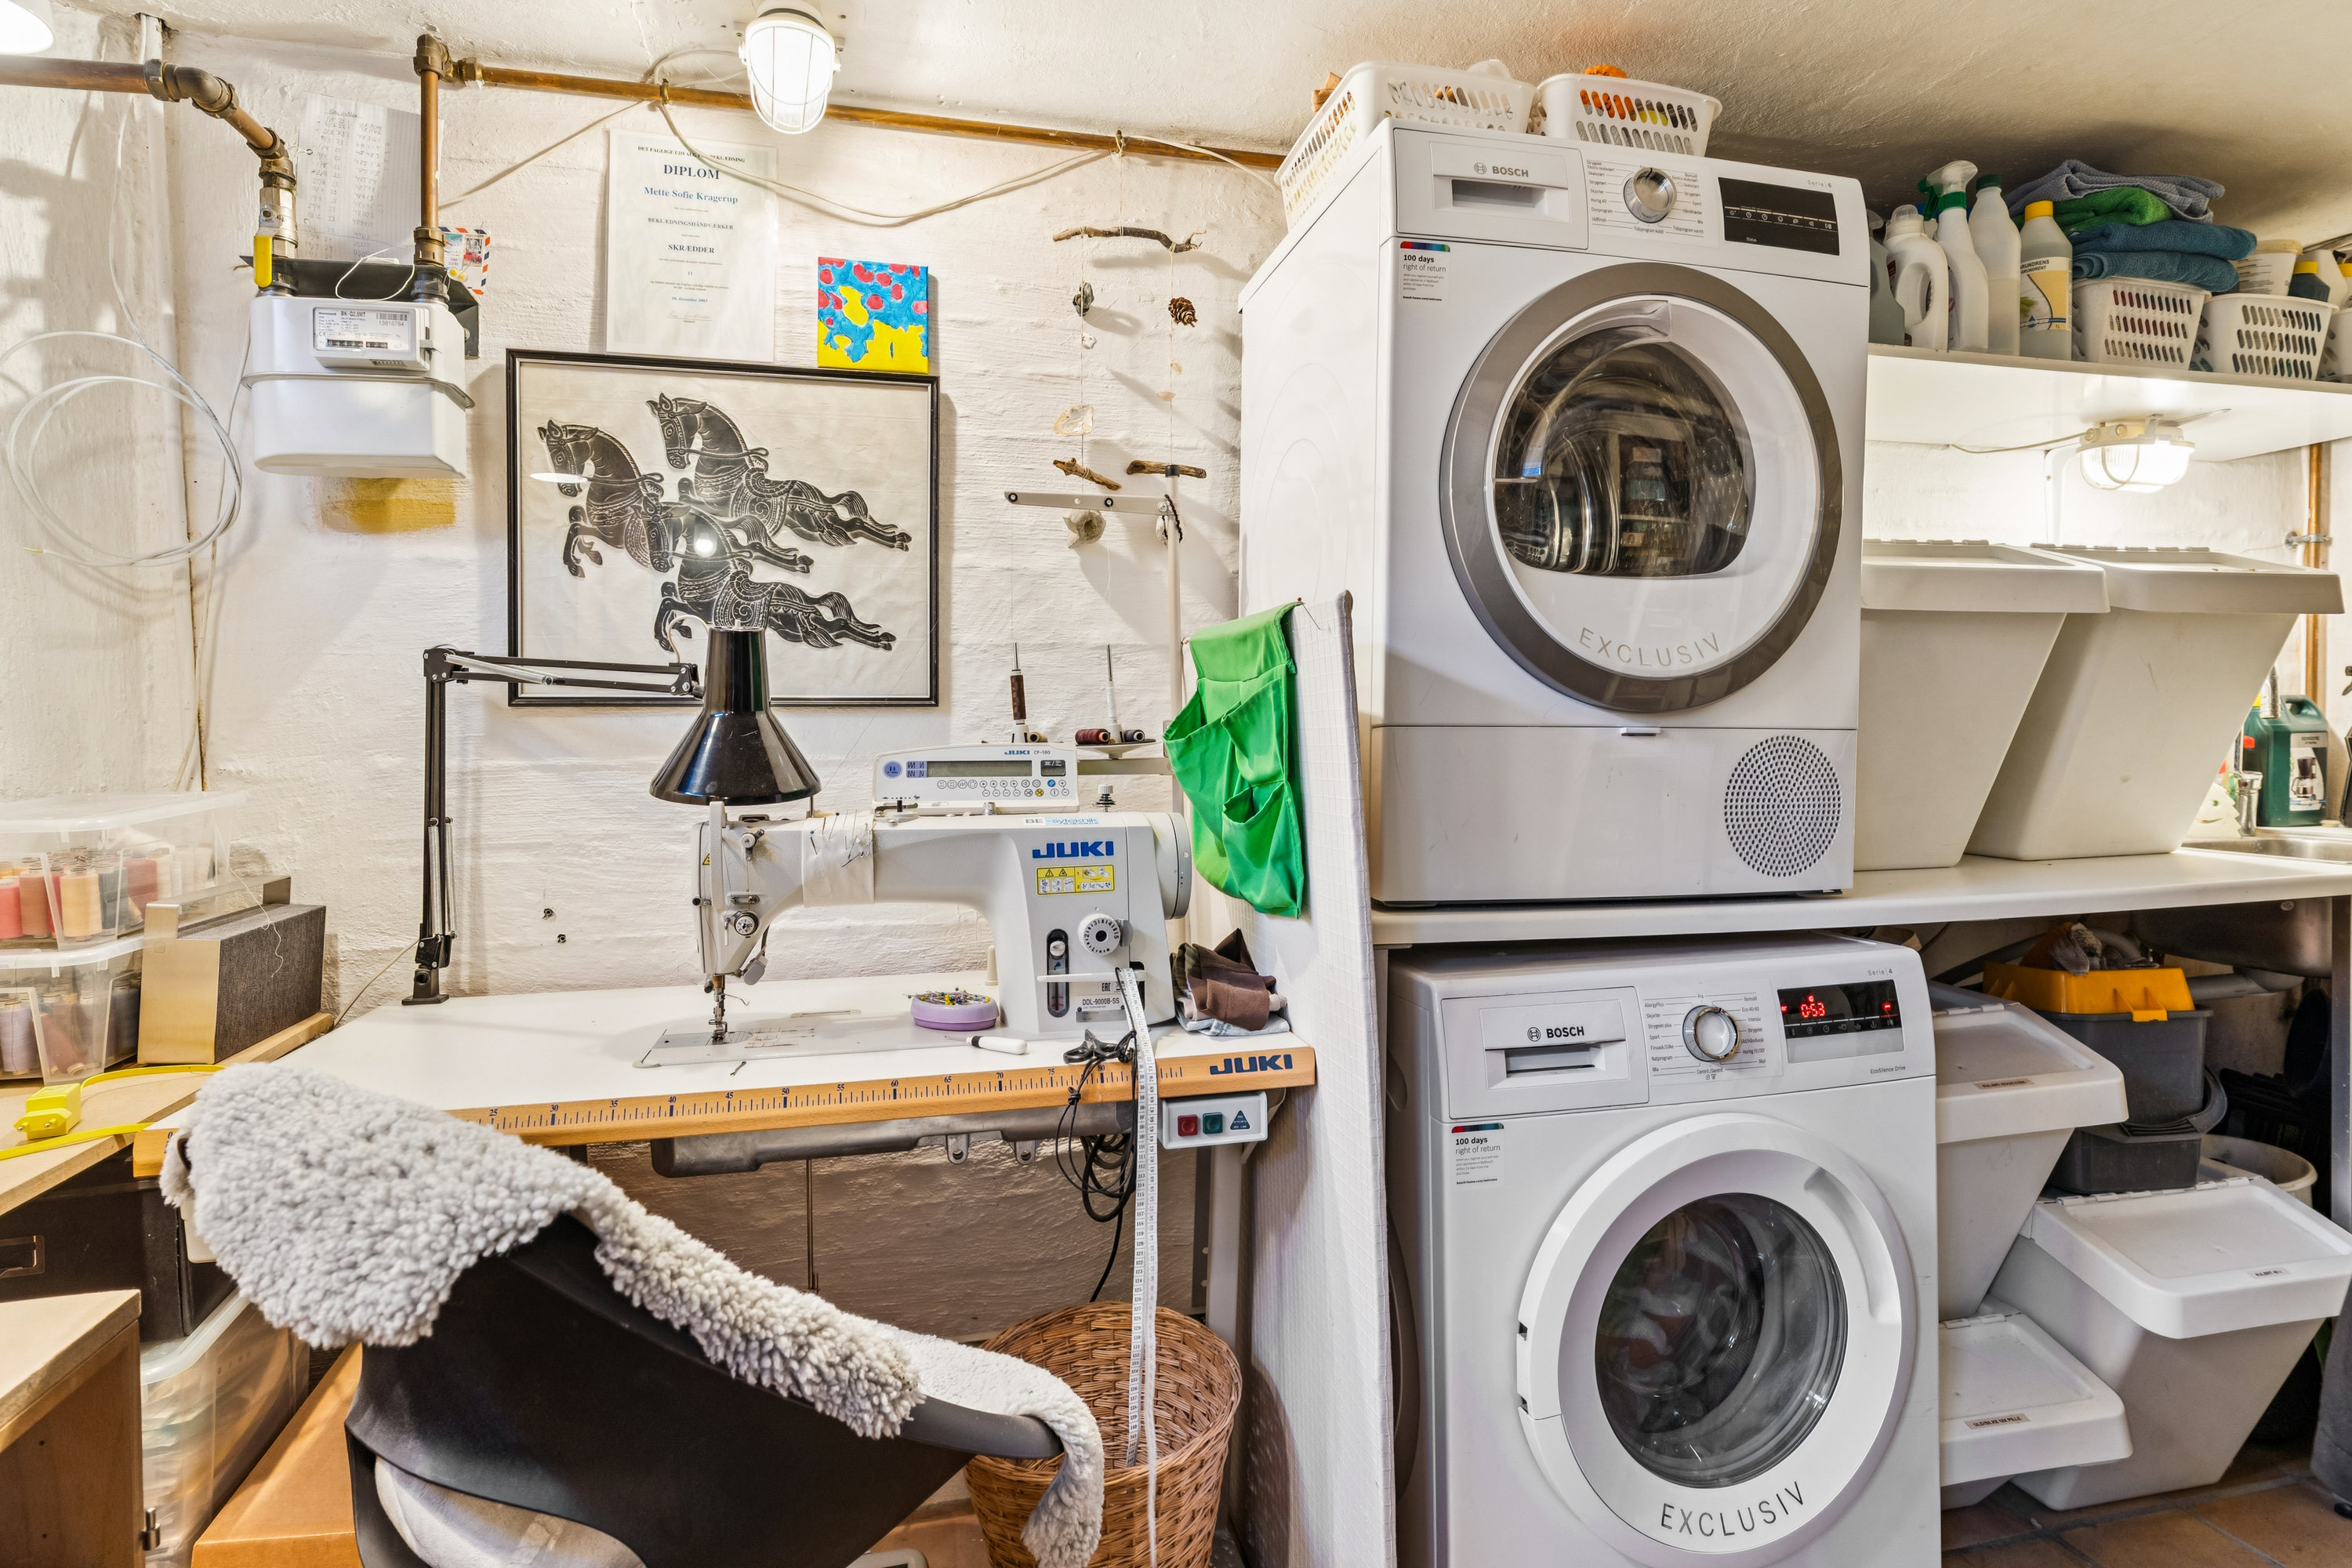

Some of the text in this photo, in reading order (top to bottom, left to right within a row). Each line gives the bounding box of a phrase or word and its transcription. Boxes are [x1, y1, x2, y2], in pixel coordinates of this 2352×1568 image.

[663, 164, 720, 179] DIPLOM
[1492, 166, 1529, 178] BOSCH
[644, 187, 738, 204] Mette Sofie Kragerup
[668, 244, 715, 254] SKRÆDDER
[1579, 627, 1719, 666] EXCLUSIV
[1033, 841, 1114, 858] JUKI
[1800, 1002, 1826, 1018] 0:53
[1546, 1026, 1585, 1038] BOSCH
[1210, 1054, 1293, 1075] JUKI
[1455, 1147, 1470, 1155] right
[1661, 1481, 1803, 1537] EXCLUSIV
